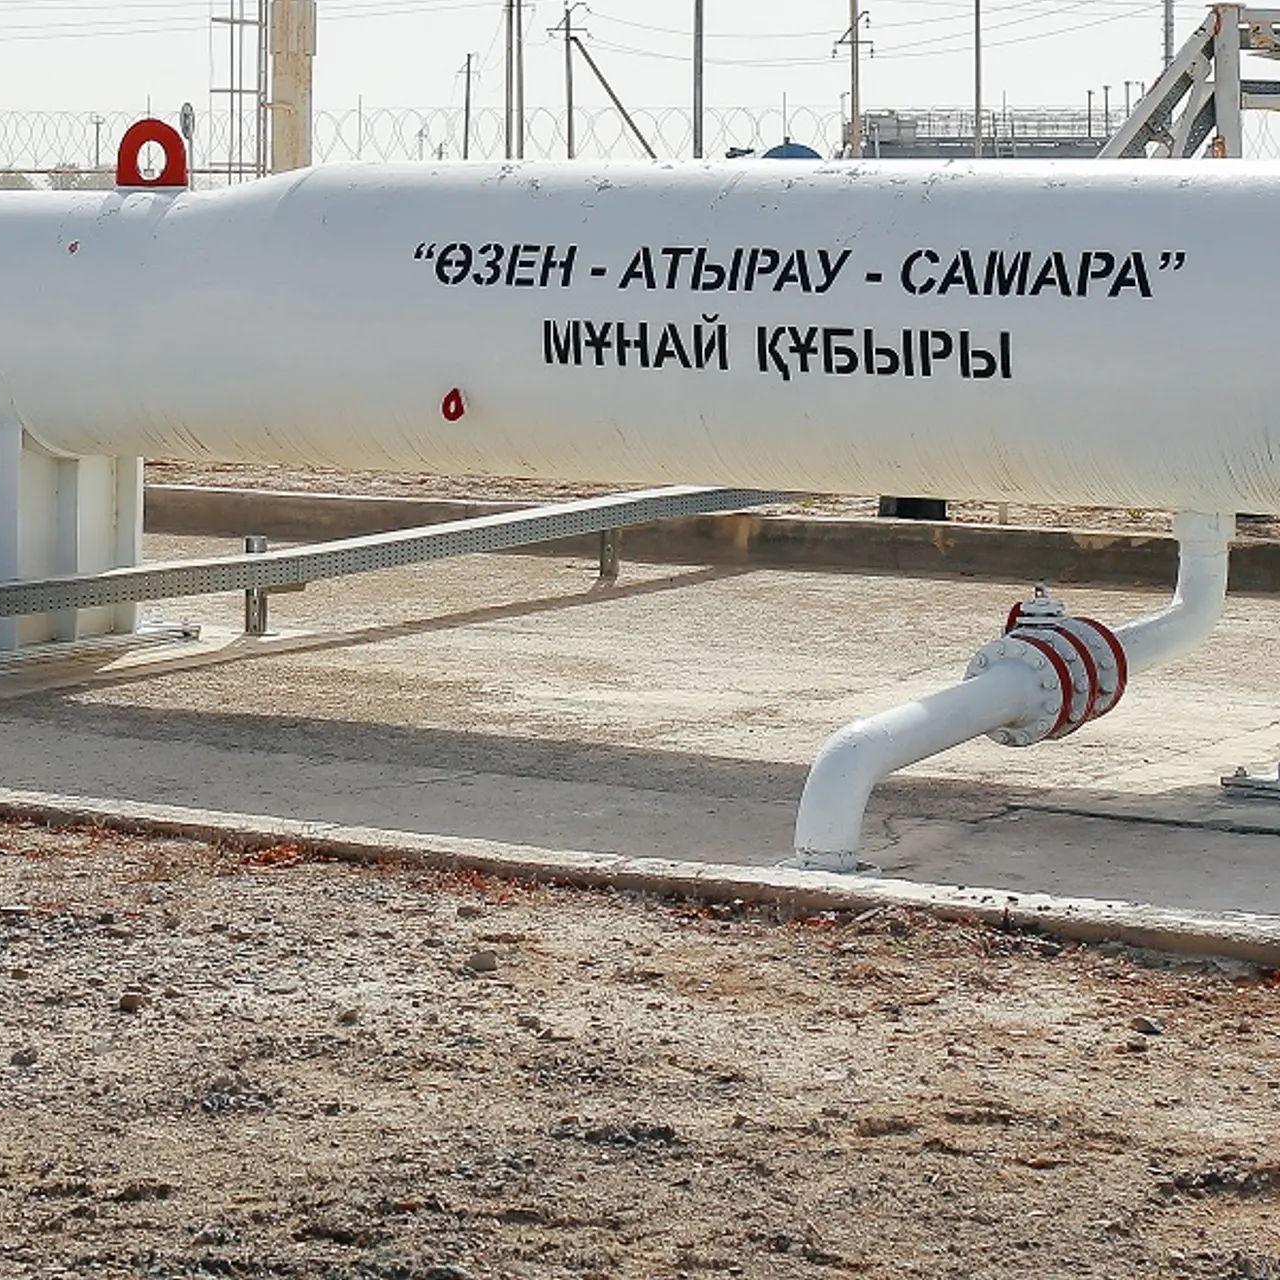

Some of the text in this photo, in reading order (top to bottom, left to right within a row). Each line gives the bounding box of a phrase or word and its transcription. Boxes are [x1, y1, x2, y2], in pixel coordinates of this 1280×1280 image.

[618, 246, 853, 294] АТЫРАУ
[543, 313, 1012, 381] МҰНАЙ ҚҰБЫРЫ
